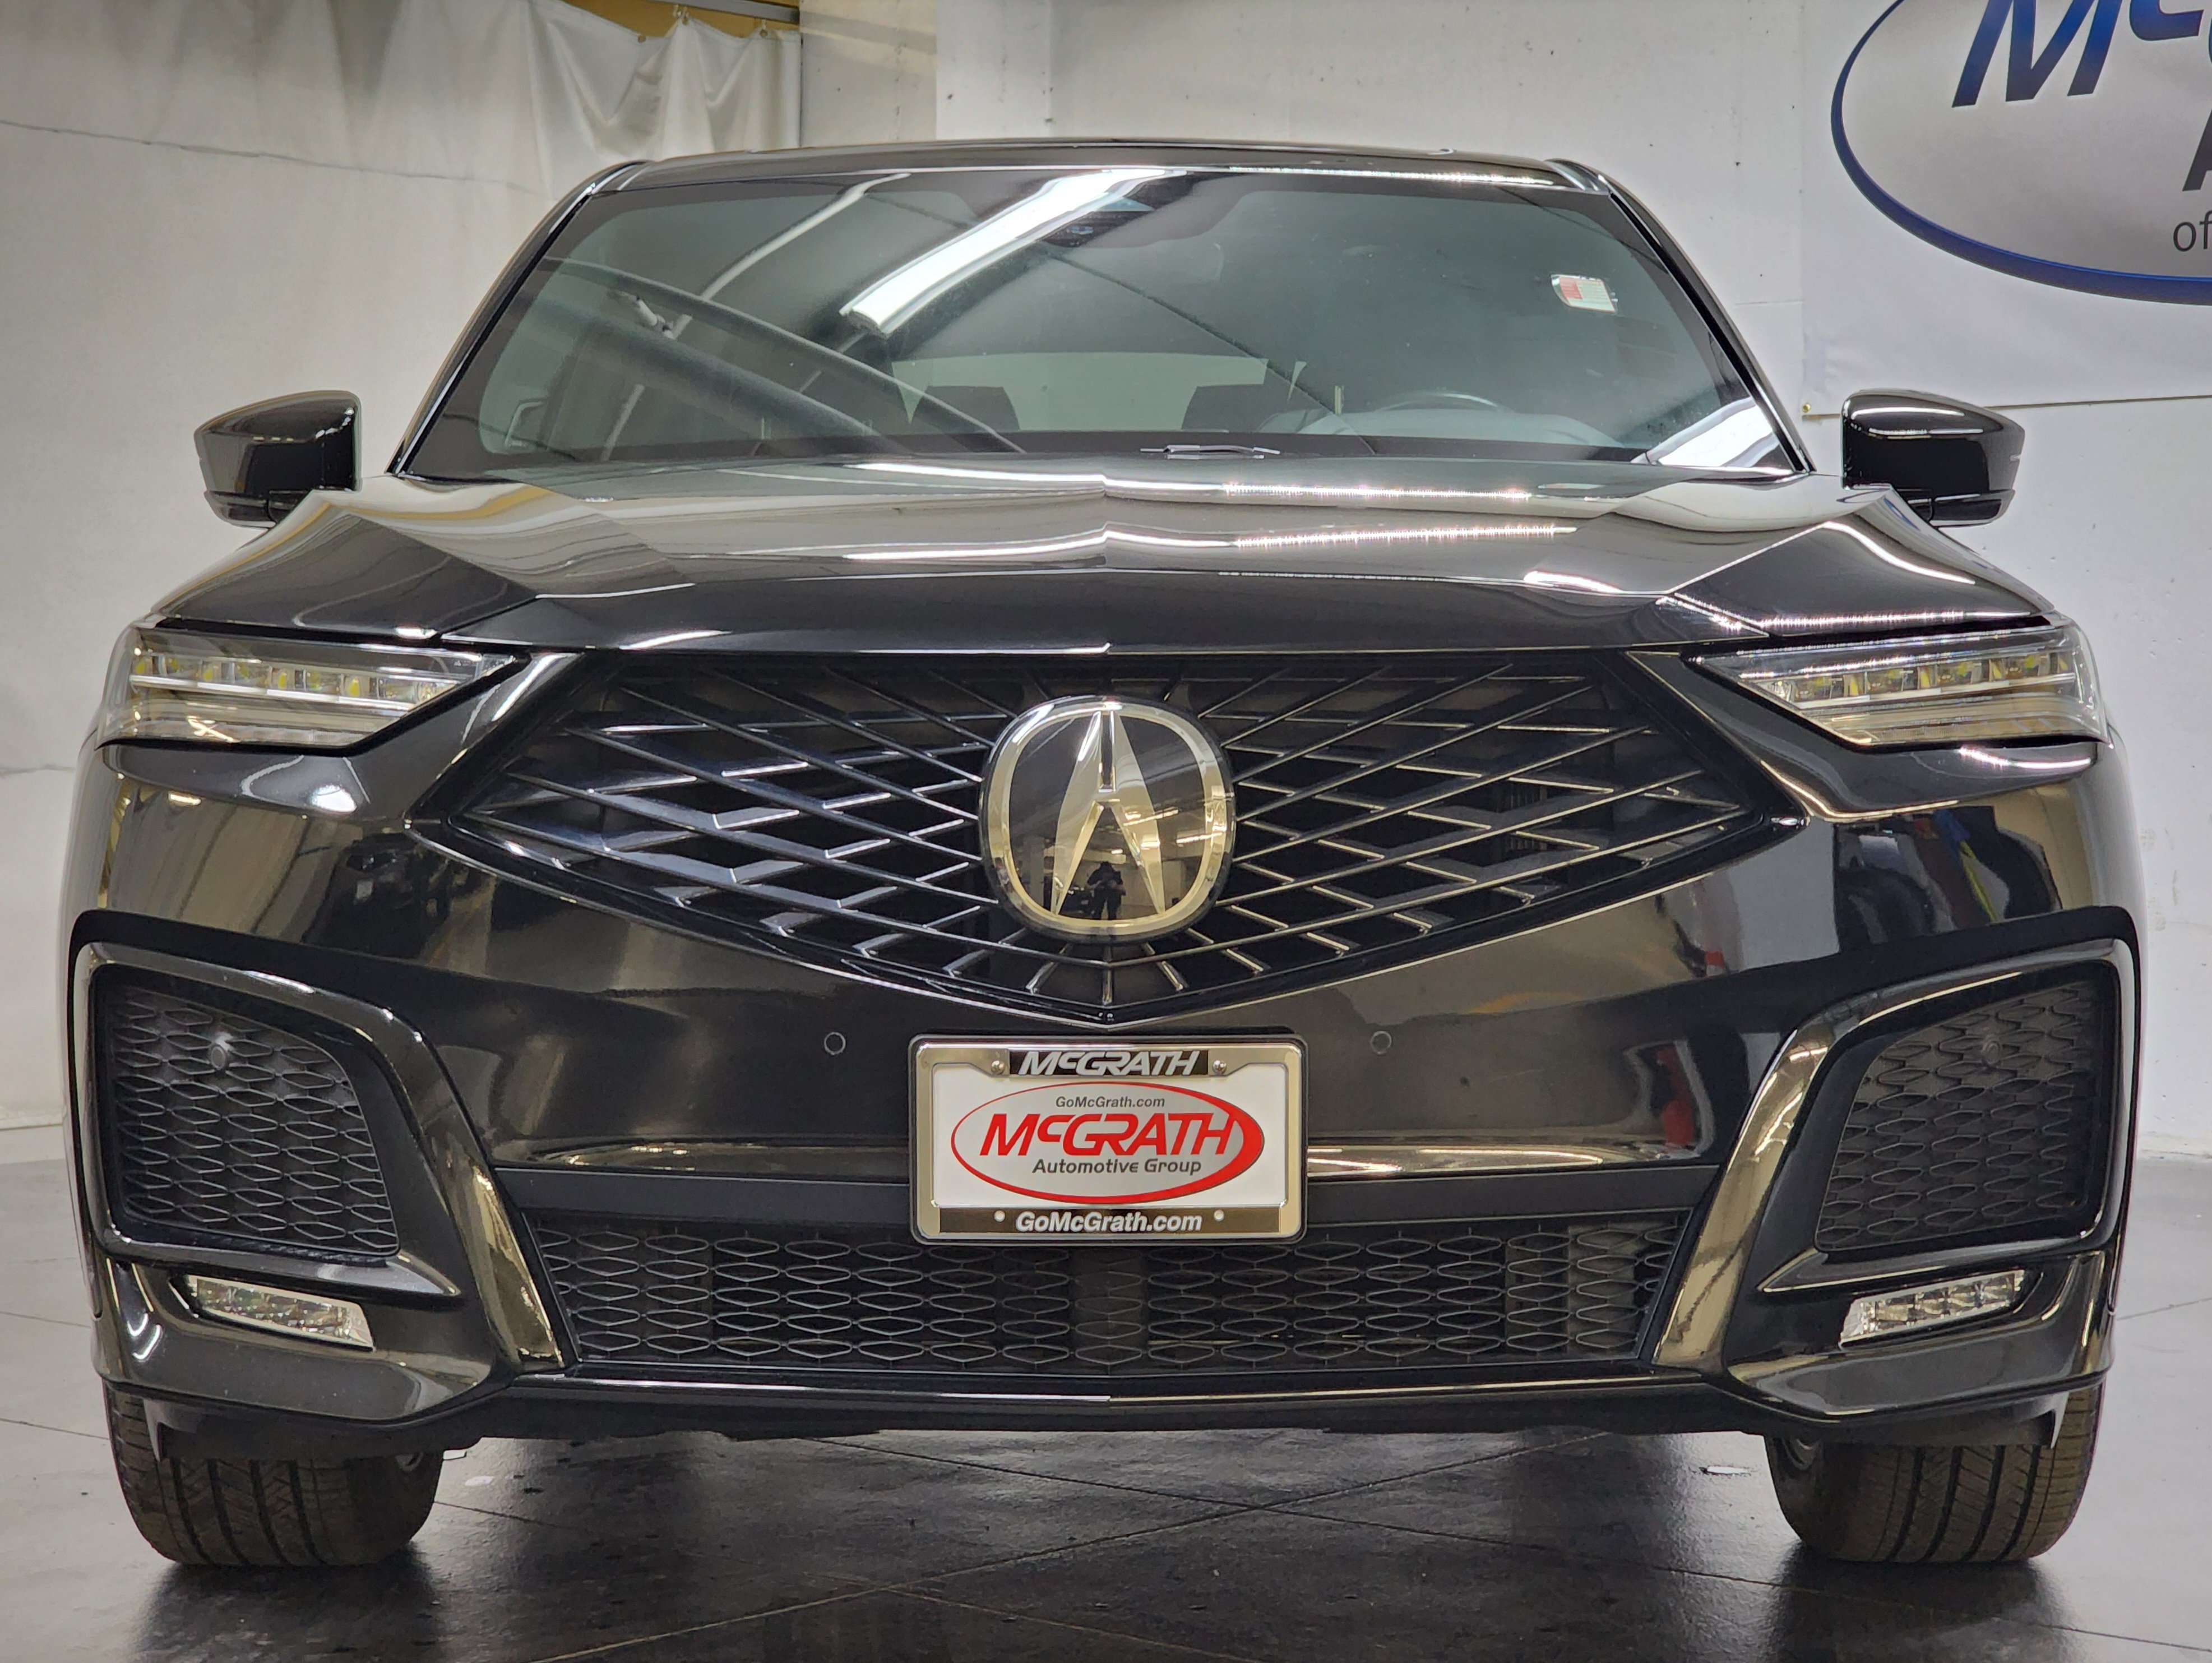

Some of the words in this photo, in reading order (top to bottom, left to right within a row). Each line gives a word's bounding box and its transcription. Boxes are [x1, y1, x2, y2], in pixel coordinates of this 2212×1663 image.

[2173, 210, 2212, 252] of
[1056, 1096, 1165, 1108] GoMcGrath.com
[1033, 1158, 1139, 1174] Automotive
[1144, 1158, 1201, 1175] Group
[1016, 1211, 1202, 1232] GoMcGrath.com
